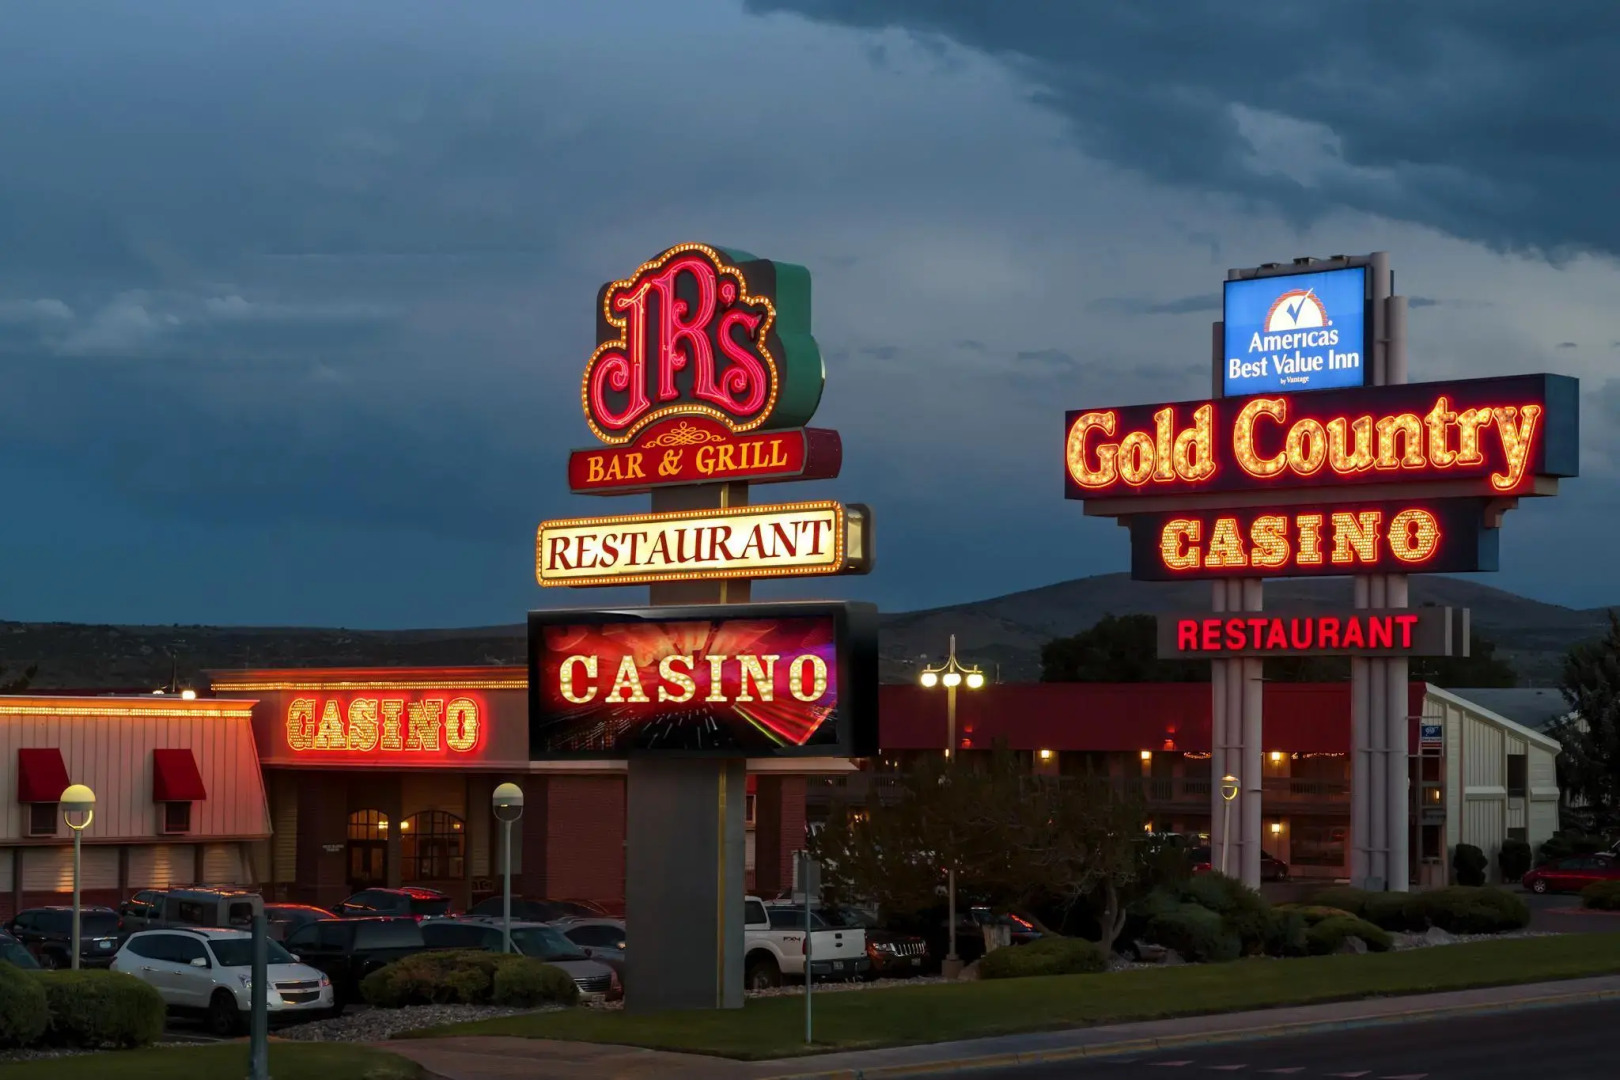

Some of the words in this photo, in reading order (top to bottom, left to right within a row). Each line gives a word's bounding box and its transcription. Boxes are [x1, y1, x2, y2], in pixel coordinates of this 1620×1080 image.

[1229, 356, 1268, 379] Best
[1272, 350, 1323, 374] Value
[1328, 349, 1360, 370] Inn
[1248, 329, 1339, 353] Americas
[586, 450, 646, 482] BAR
[658, 449, 683, 475] &
[696, 439, 788, 475] GRILL
[1066, 403, 1217, 488] Gold
[1233, 396, 1542, 491] Country
[546, 519, 832, 570] RESTAURANT
[1160, 508, 1441, 570] CASINO
[1177, 615, 1419, 651] RESTAURANT
[559, 654, 828, 703] CASINO
[287, 698, 480, 752] CASINO
